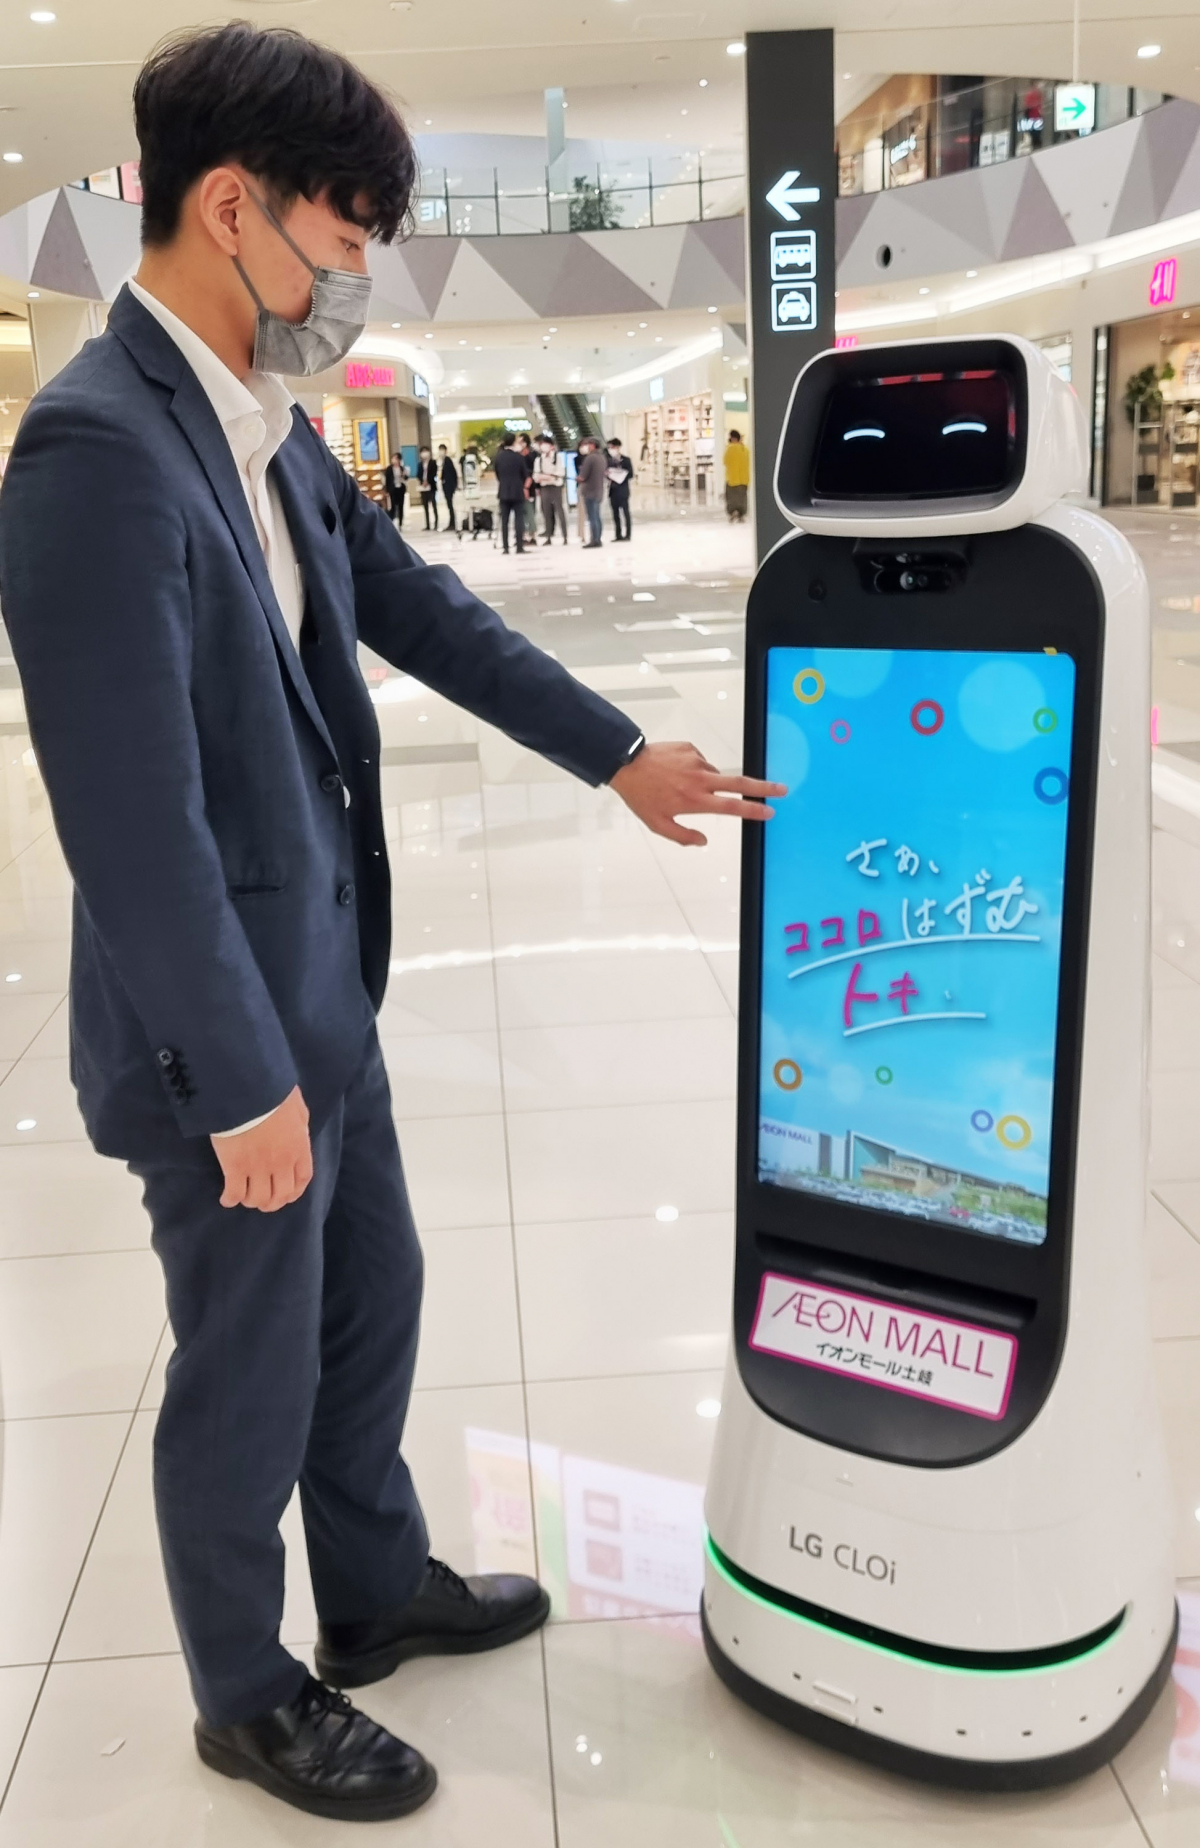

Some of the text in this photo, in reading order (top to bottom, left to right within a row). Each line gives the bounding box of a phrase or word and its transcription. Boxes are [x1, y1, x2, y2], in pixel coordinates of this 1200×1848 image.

[815, 1342, 935, 1387] イオンモール土岐
[885, 1316, 994, 1379] MALL
[789, 1525, 897, 1585] LG CLOi
